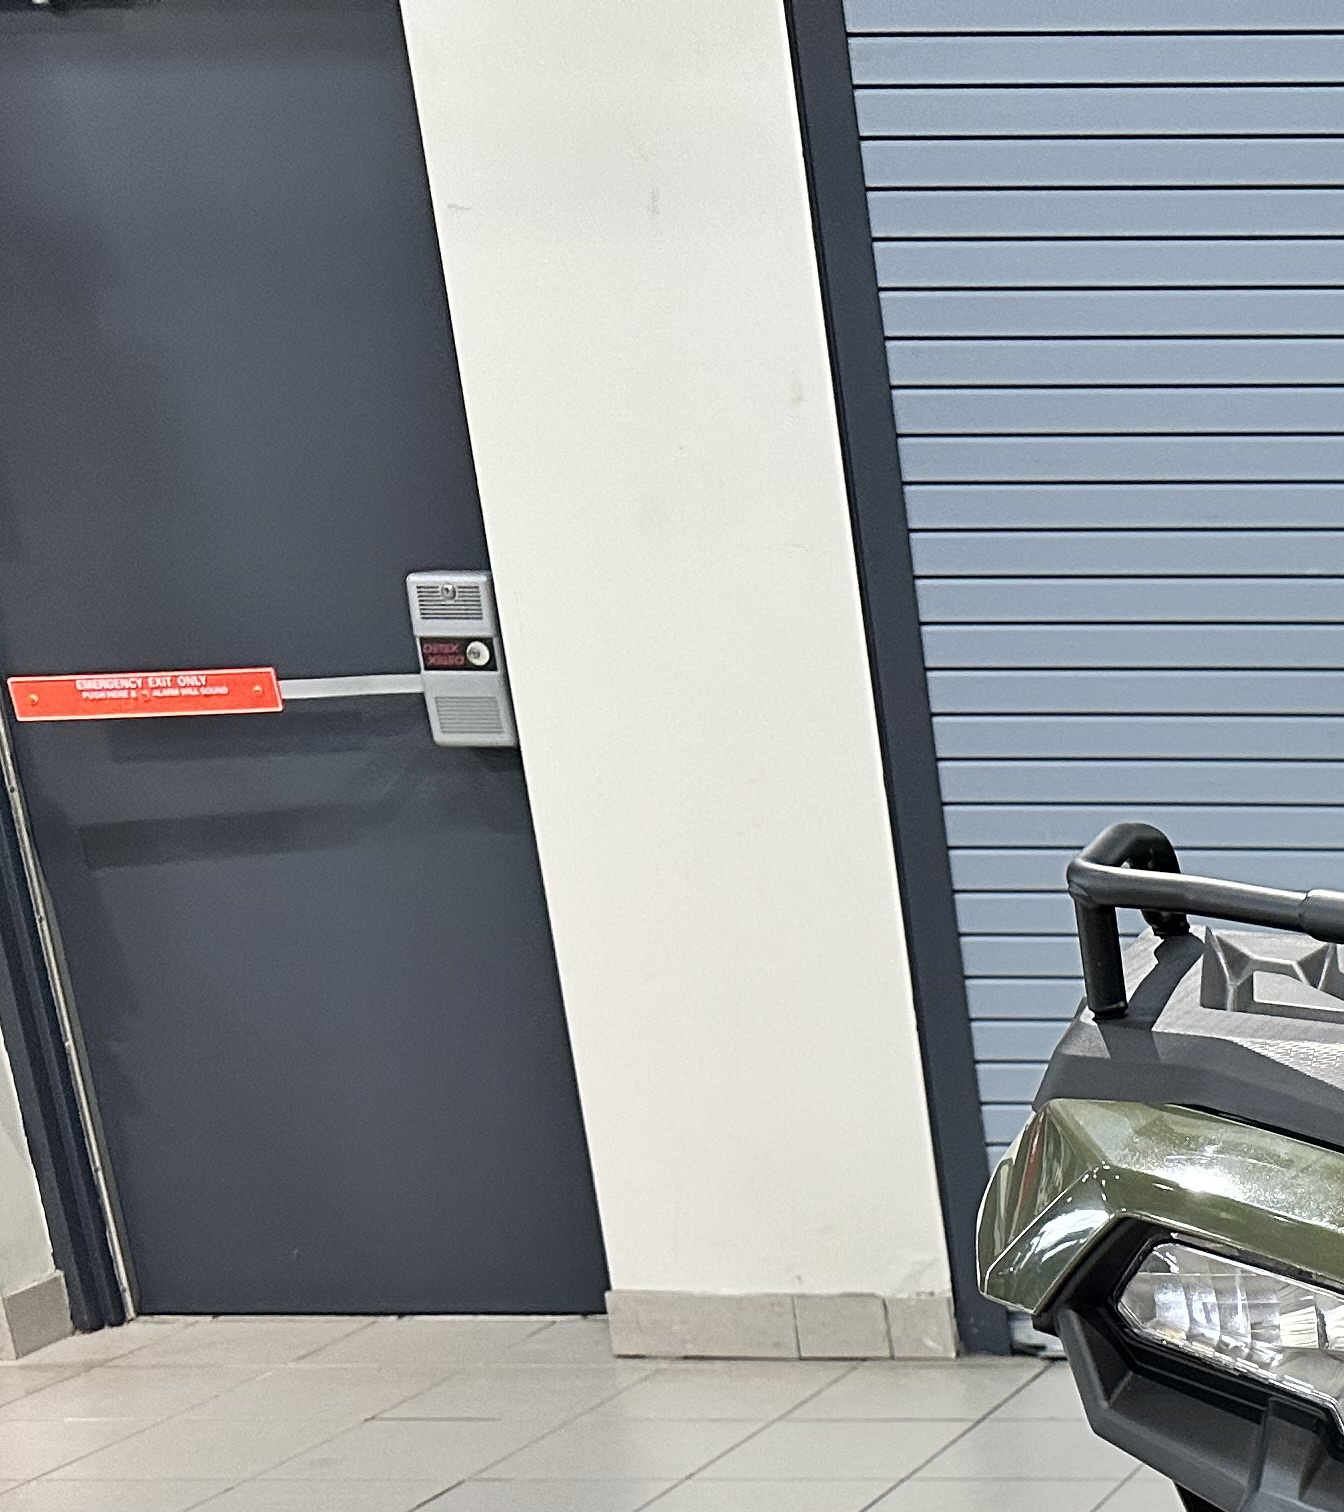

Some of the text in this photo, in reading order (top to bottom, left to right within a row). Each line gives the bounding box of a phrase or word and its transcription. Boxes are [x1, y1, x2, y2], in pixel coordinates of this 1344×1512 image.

[76, 675, 207, 691] EMERGENCY EXIT ONLY
